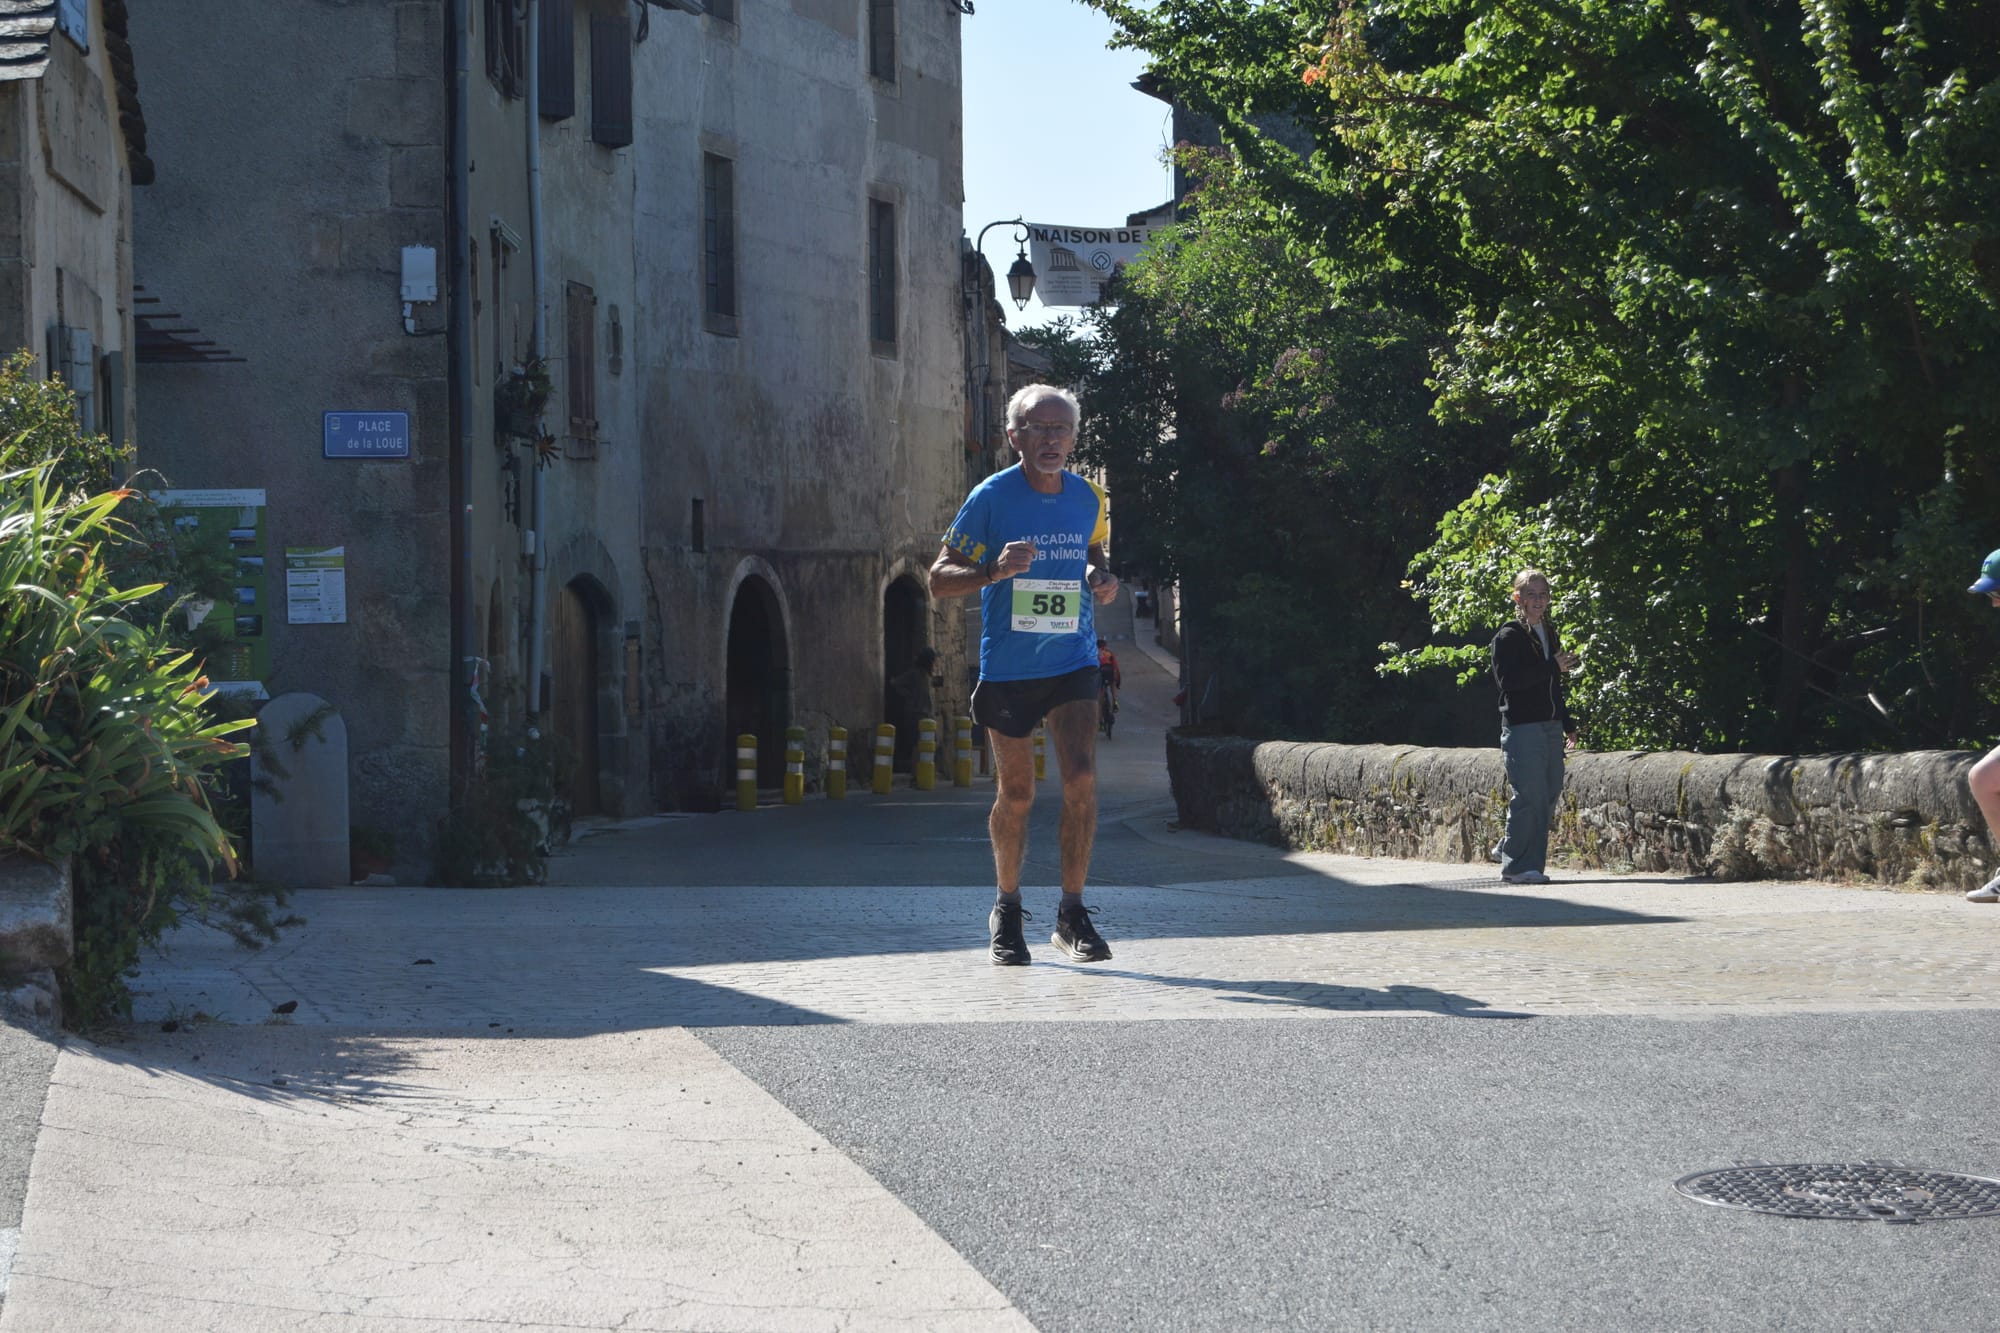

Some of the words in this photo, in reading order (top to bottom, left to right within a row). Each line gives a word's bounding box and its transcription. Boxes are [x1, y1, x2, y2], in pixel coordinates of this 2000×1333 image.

[1034, 228, 1111, 244] MAISON
[1118, 230, 1142, 244] DE
[358, 420, 391, 432] PLACE
[347, 437, 359, 449] de
[363, 437, 372, 448] la
[376, 437, 403, 449] LOUE
[1020, 533, 1083, 545] MACADAM
[1032, 594, 1066, 616] 58
